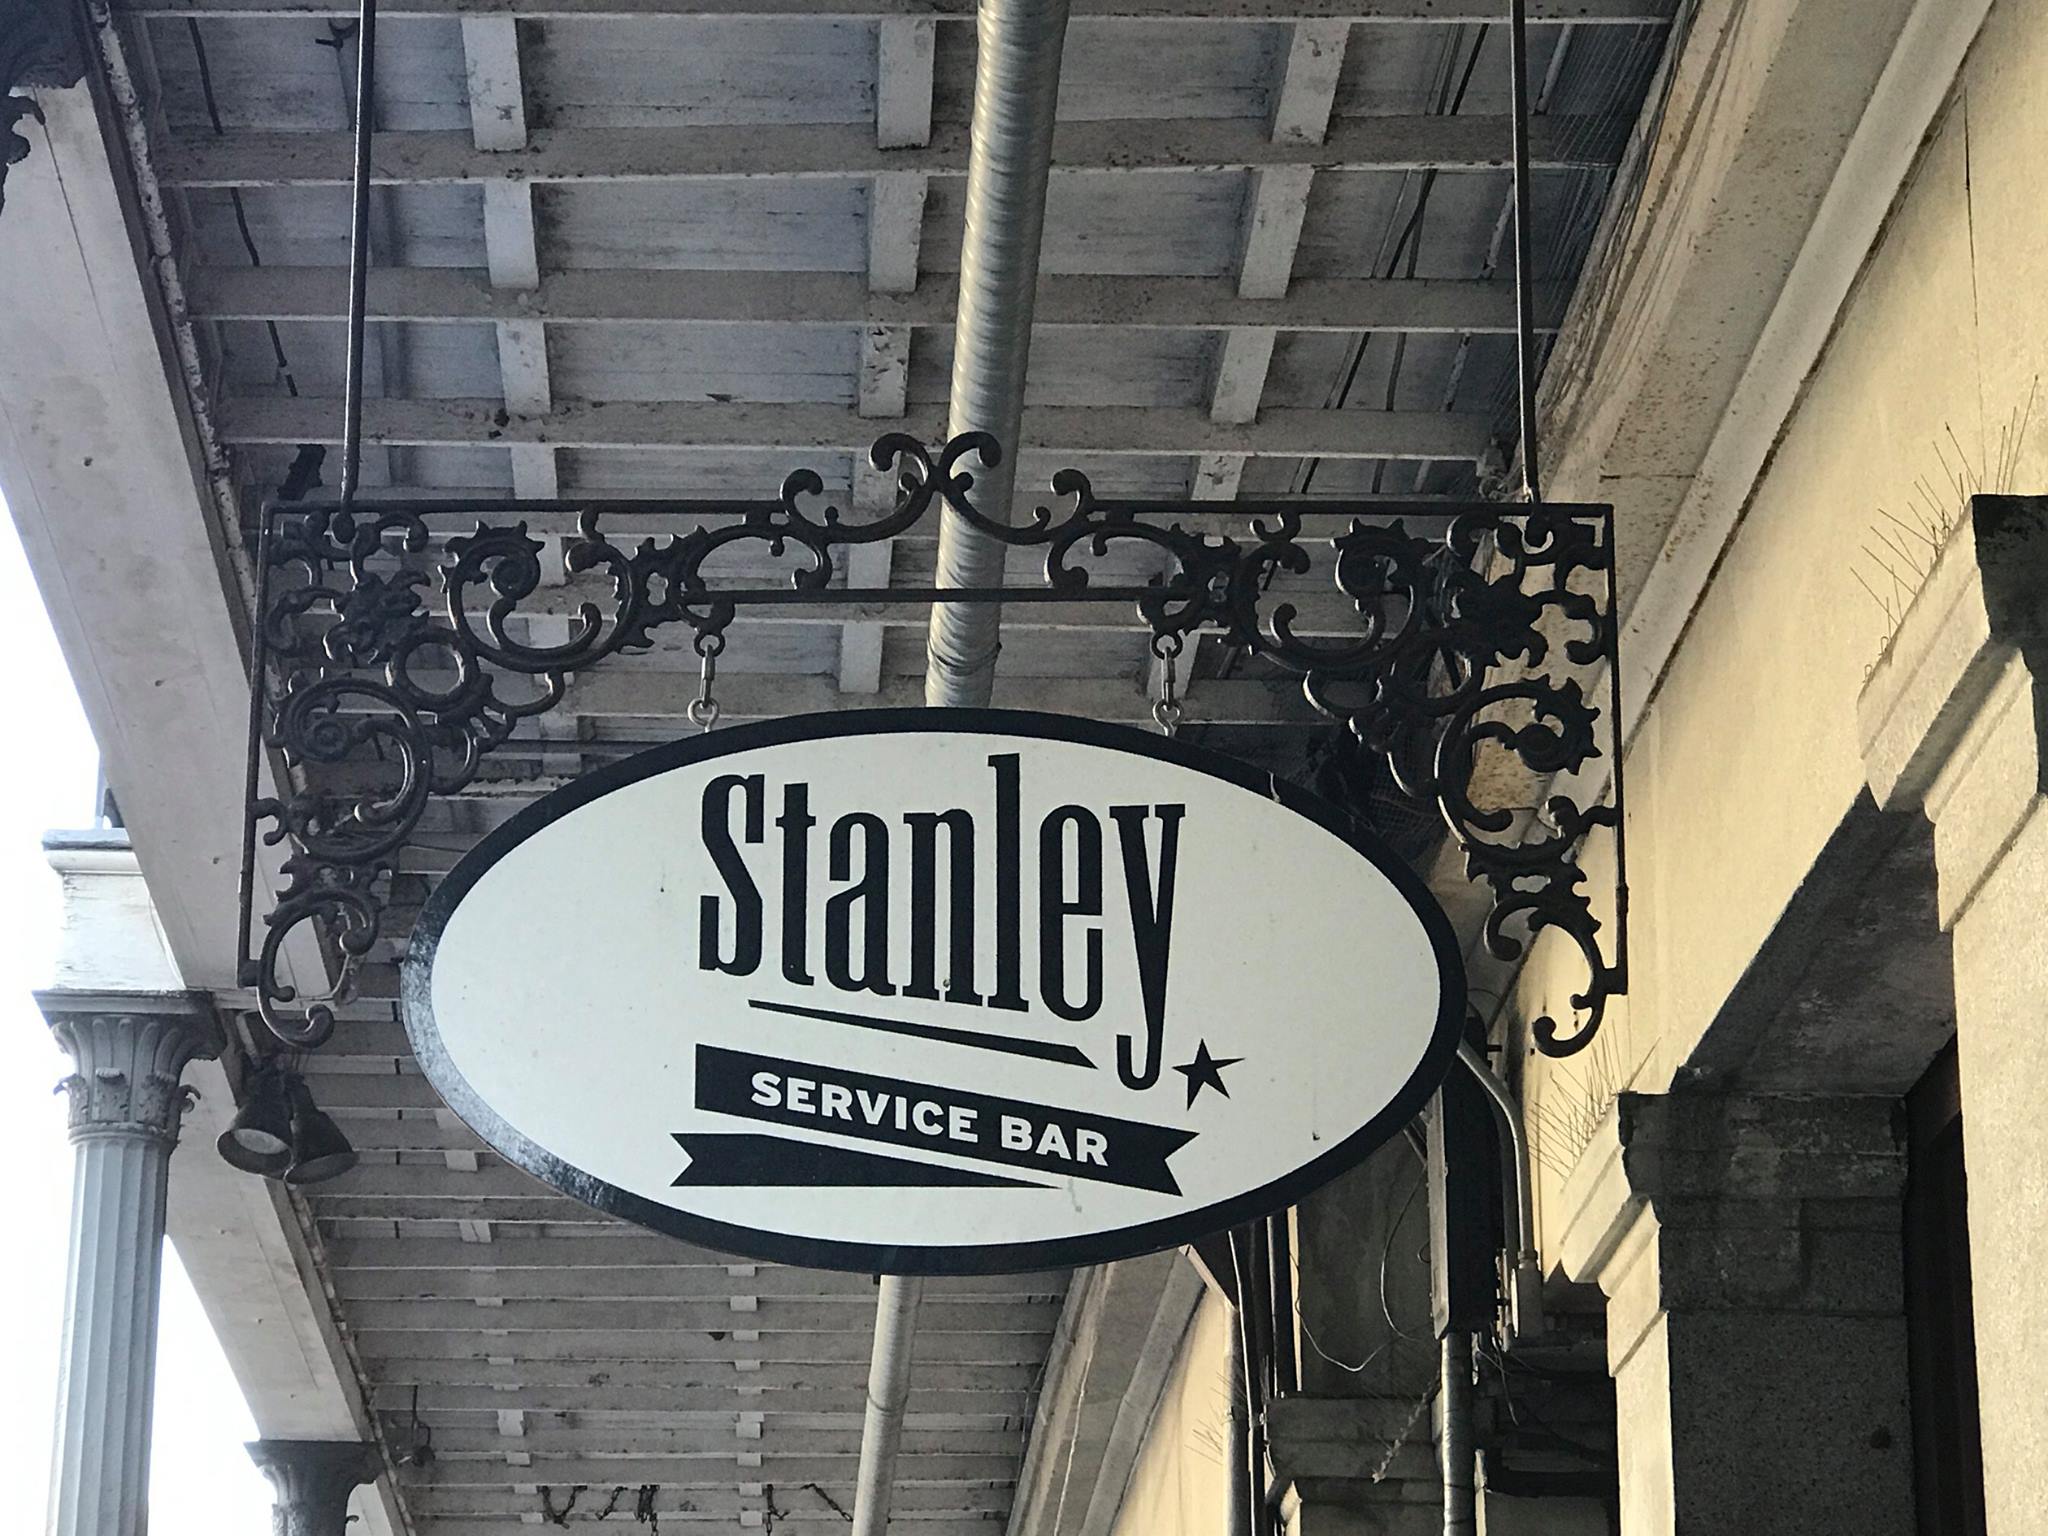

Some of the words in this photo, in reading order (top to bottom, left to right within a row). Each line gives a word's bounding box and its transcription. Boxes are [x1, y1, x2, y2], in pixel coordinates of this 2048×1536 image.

[699, 753, 1186, 1091] Stanley
[750, 1071, 979, 1143] SERVICE
[1001, 1114, 1109, 1167] BAR
